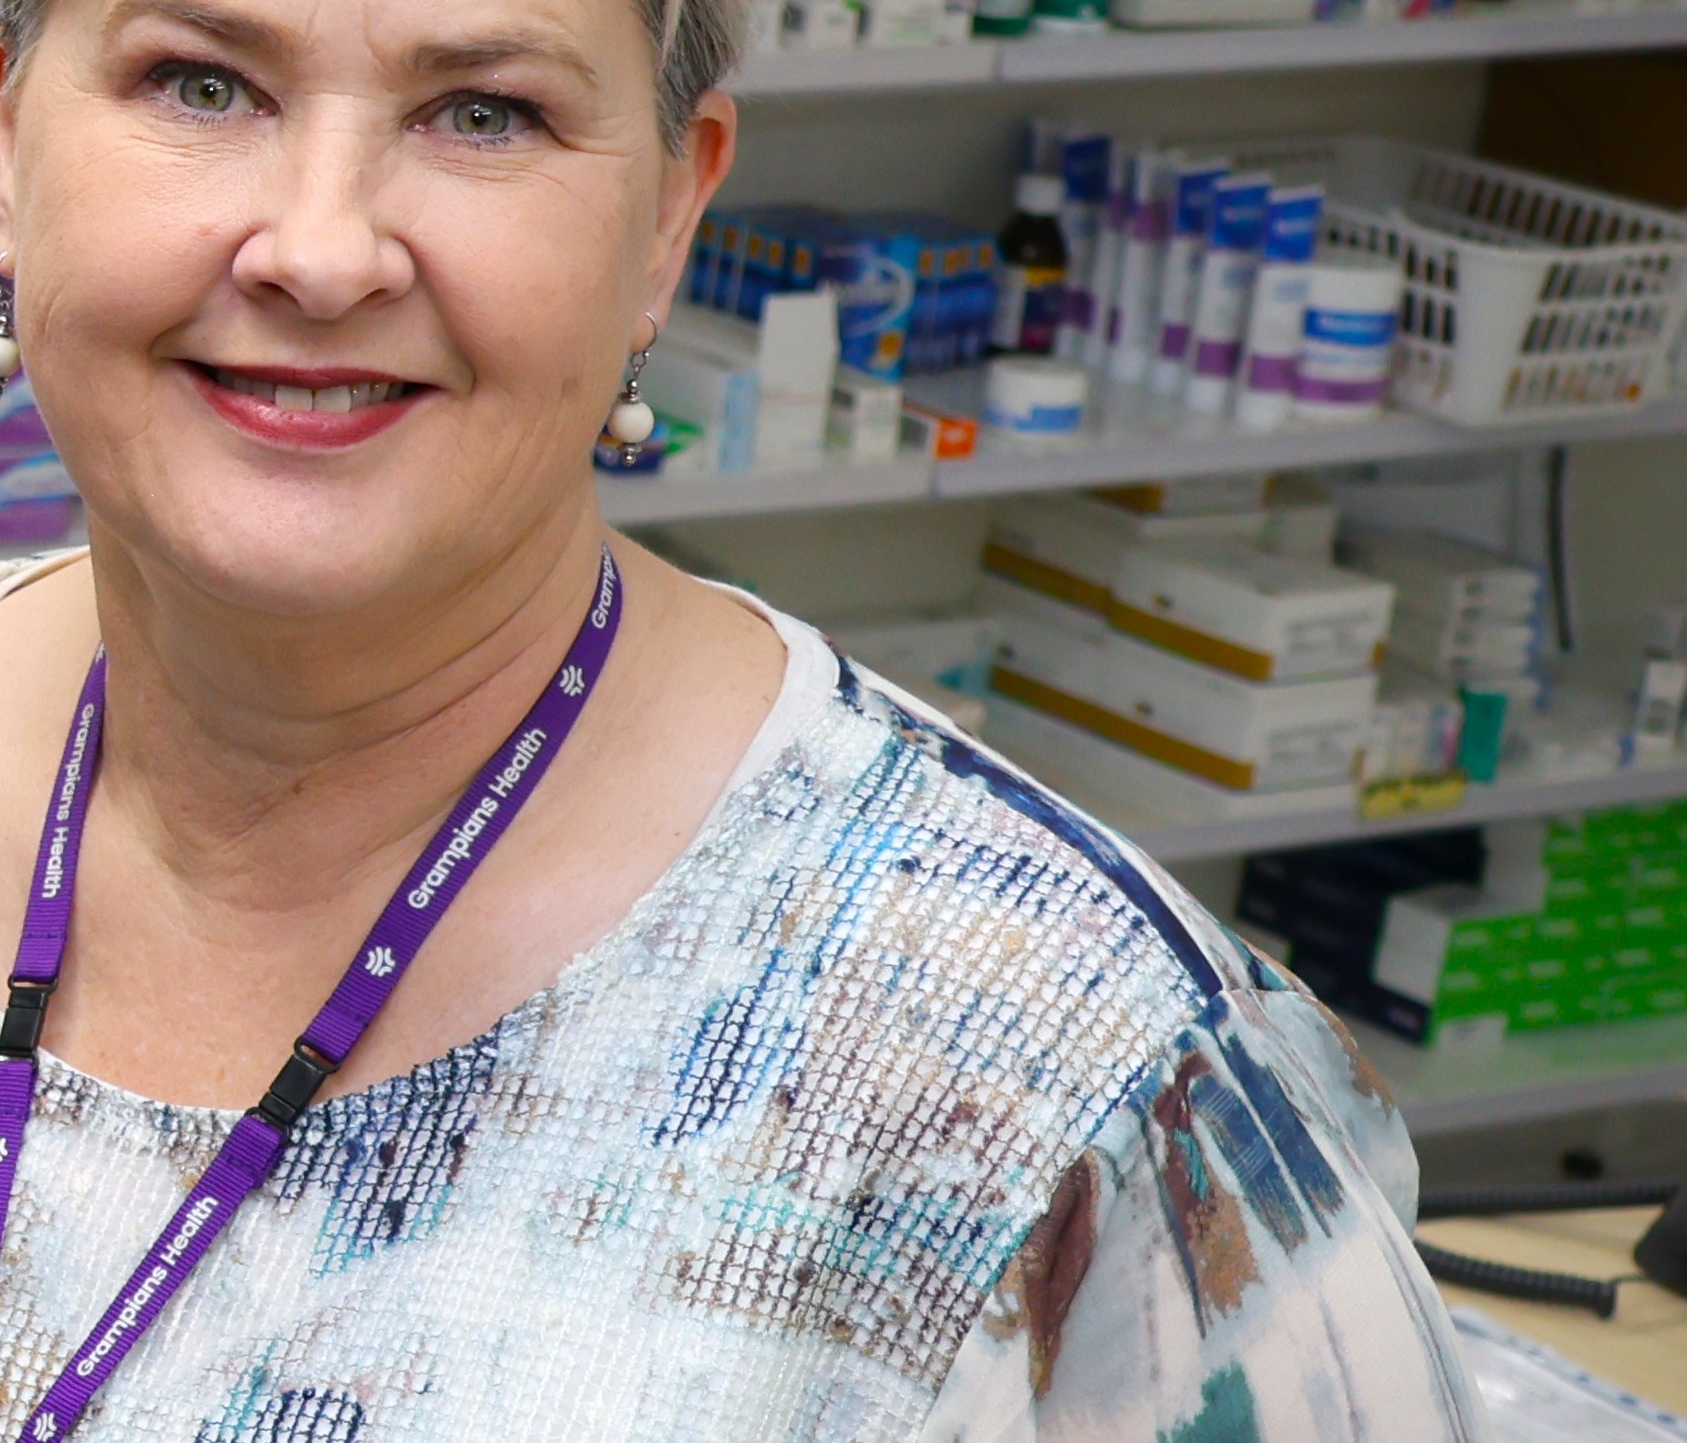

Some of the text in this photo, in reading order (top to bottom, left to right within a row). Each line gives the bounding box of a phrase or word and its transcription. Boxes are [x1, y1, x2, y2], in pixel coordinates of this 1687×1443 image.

[41, 702, 95, 899] Grampians Health
[407, 727, 548, 909] Grampians Health
[76, 1195, 219, 1377] Grampians Health
